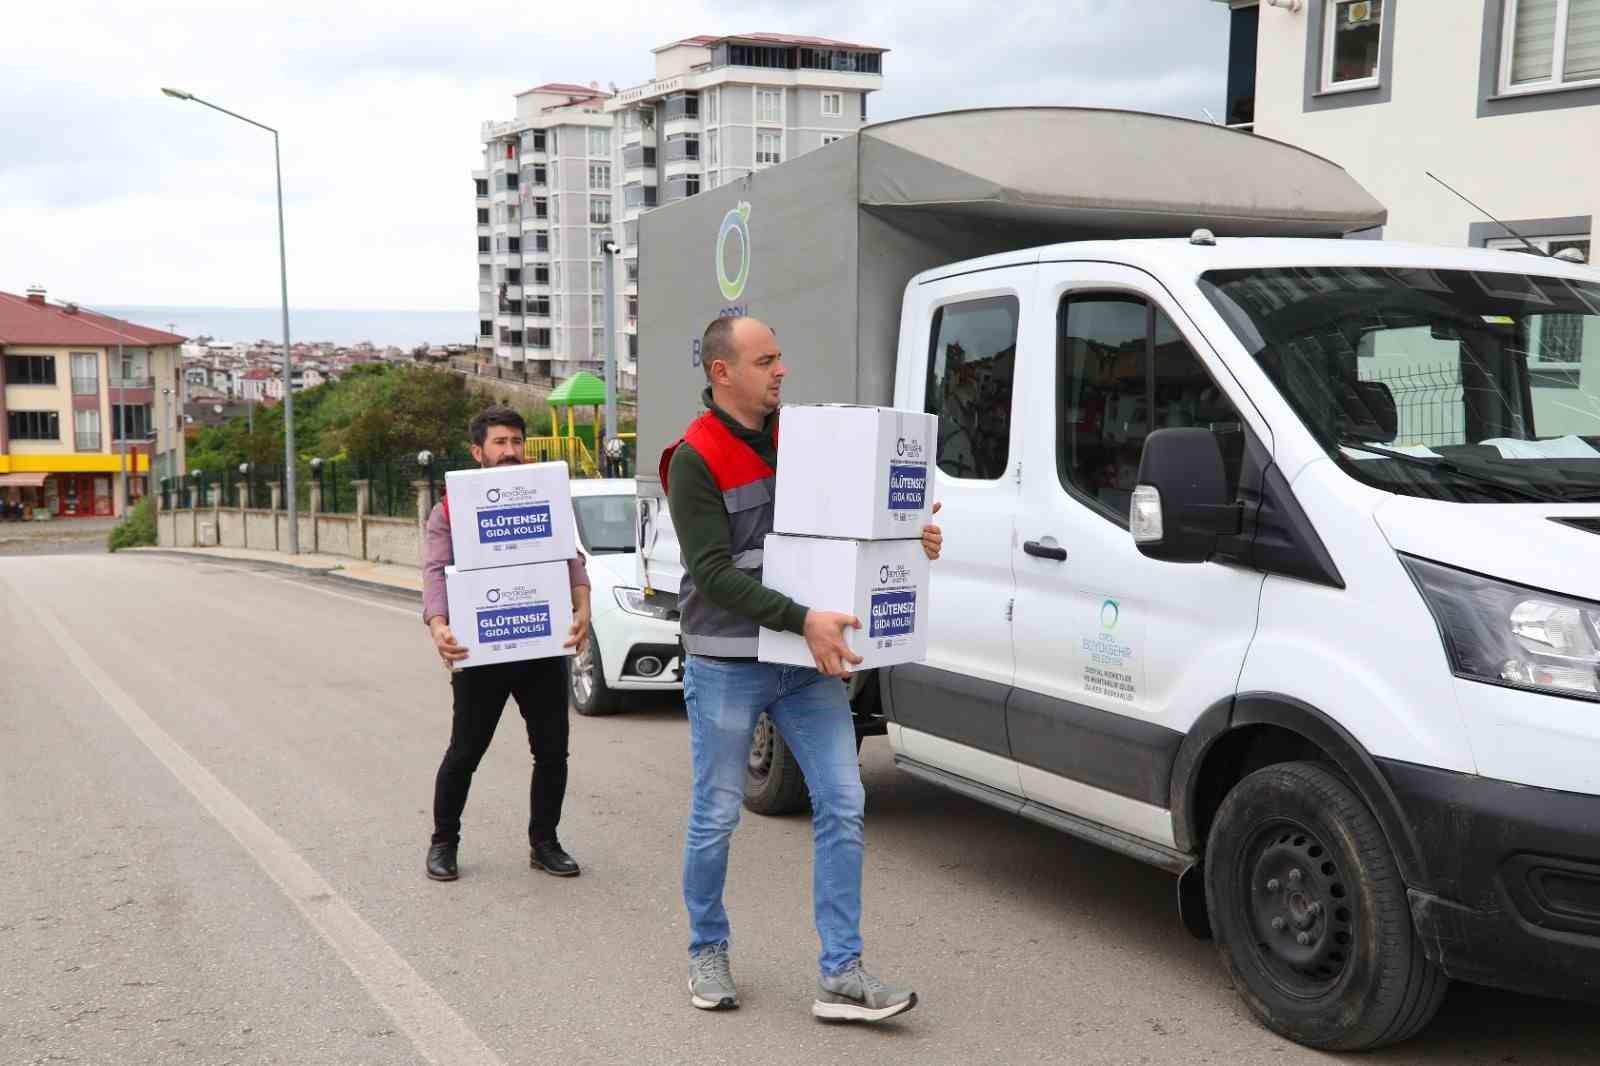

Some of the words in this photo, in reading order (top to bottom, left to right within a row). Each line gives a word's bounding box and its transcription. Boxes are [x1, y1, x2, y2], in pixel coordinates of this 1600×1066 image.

[480, 513, 548, 529] GLÜTENSİZ
[486, 528, 511, 538] GIDA
[513, 525, 545, 536] KOLİSİ
[872, 601, 915, 616] GLÜTENSİZ
[480, 612, 548, 628] GLÜTENSİZ
[874, 619, 890, 630] GIDA
[485, 628, 510, 638] GIDA
[513, 624, 544, 635] KOLİSİ
